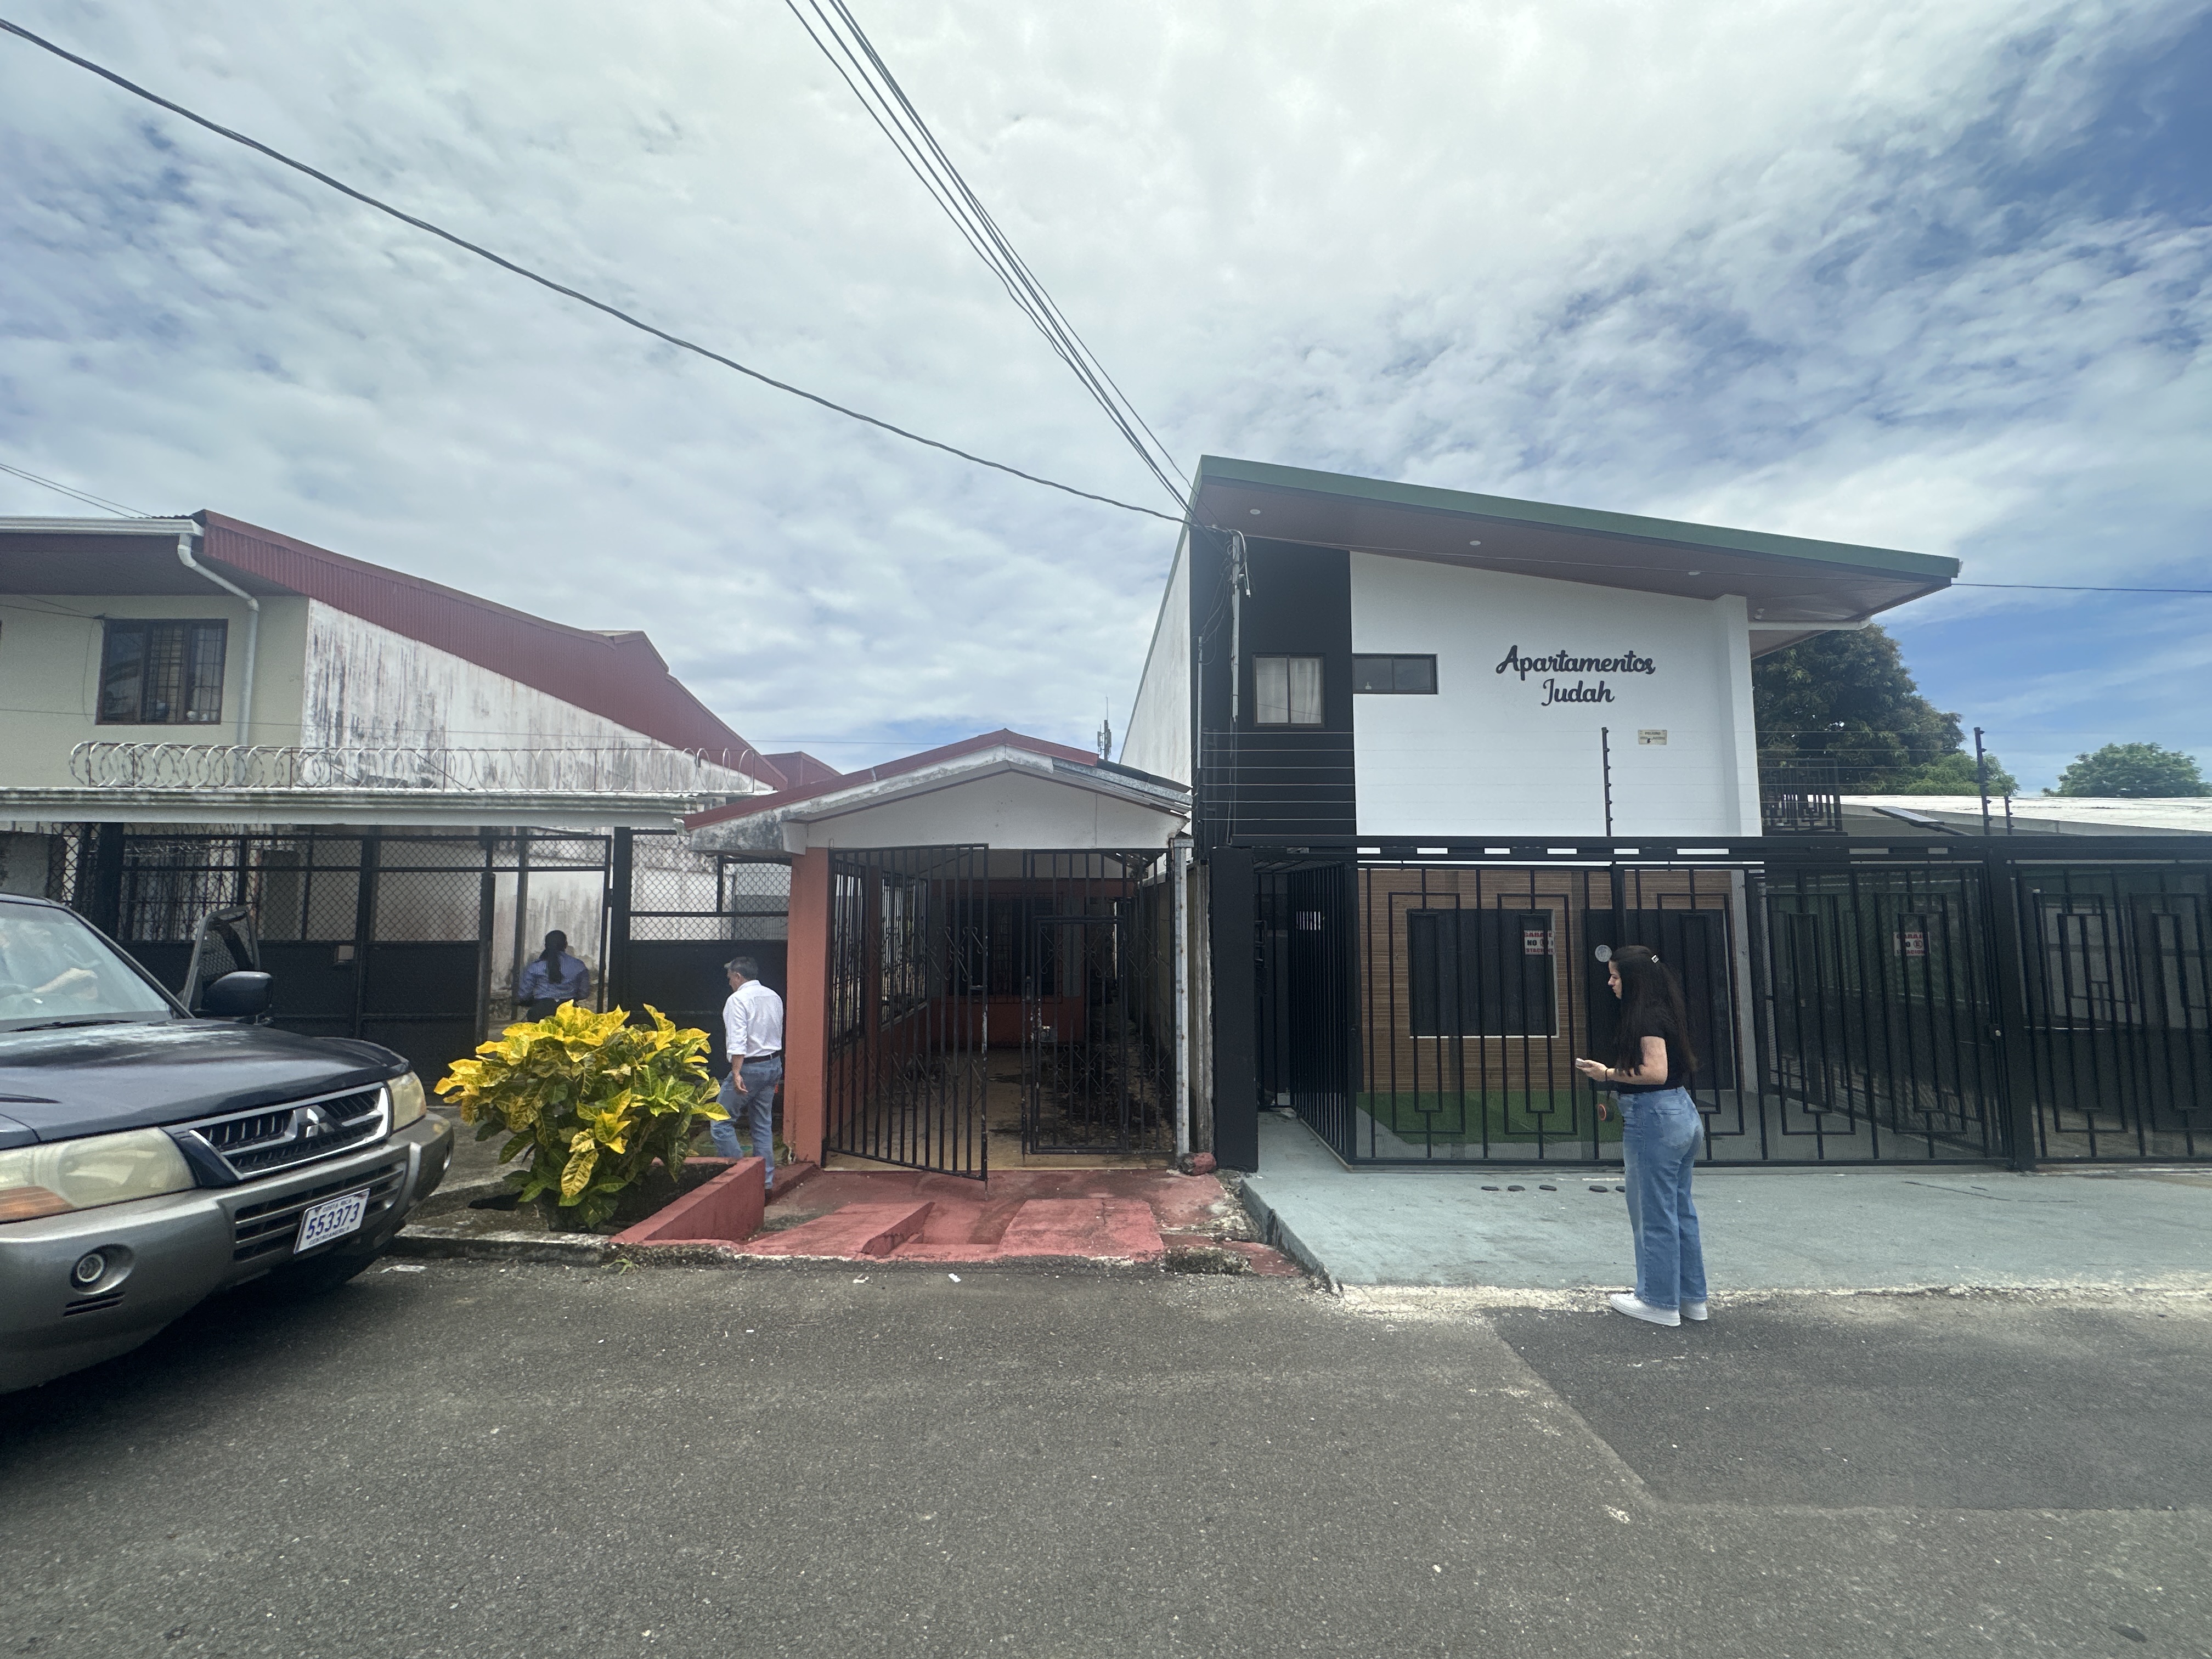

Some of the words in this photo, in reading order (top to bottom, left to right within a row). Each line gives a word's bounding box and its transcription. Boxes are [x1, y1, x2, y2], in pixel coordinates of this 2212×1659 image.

[1496, 645, 1656, 681] Apartamentos
[1541, 678, 1615, 706] Judah
[306, 1202, 360, 1240] 553373
